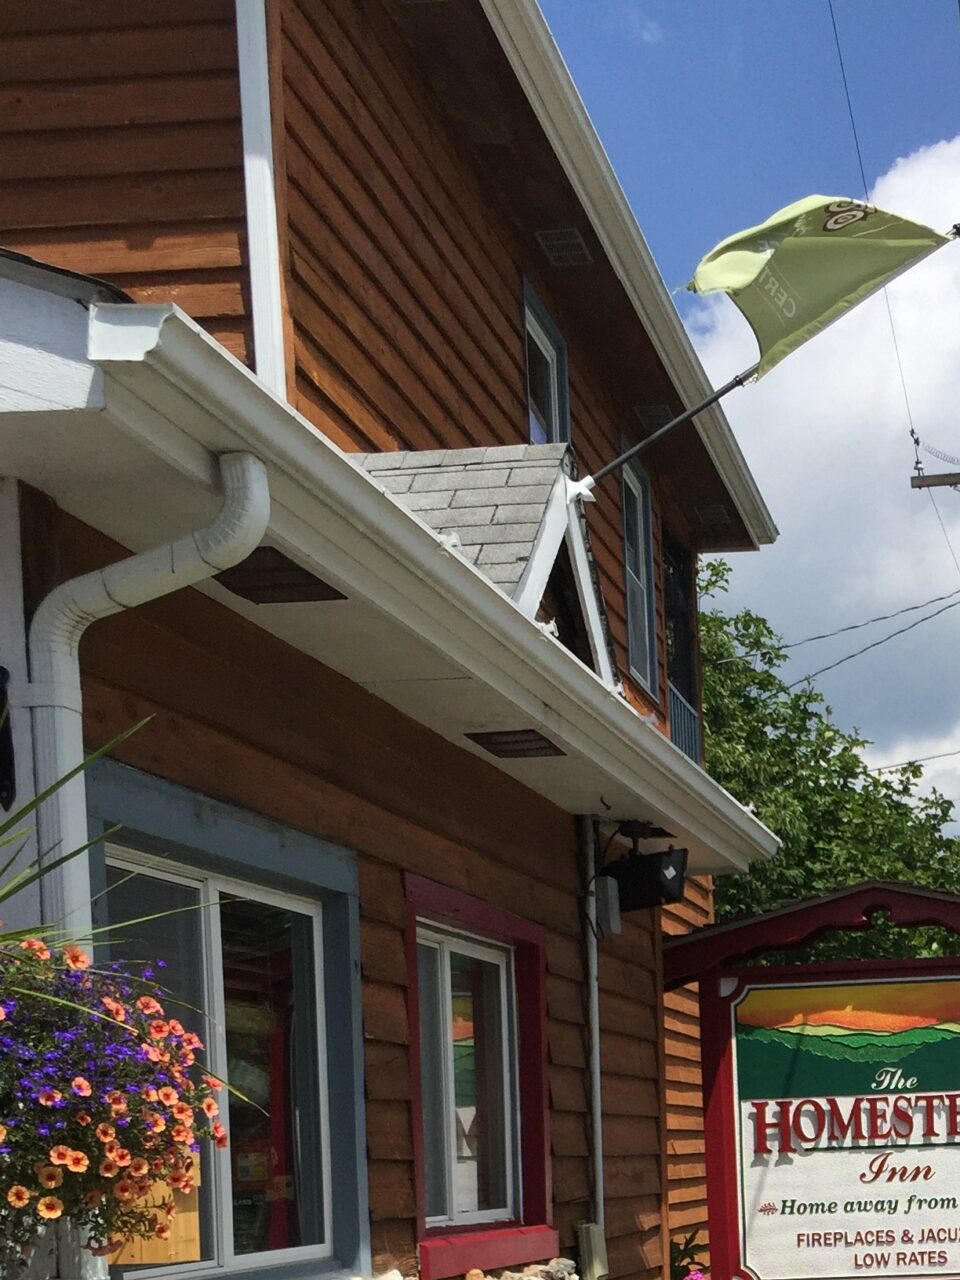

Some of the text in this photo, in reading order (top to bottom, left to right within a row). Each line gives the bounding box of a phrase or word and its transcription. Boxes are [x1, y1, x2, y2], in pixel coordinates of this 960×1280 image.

[871, 1067, 919, 1090] The
[859, 1151, 936, 1184] Inn
[780, 1199, 838, 1216] Home
[843, 1199, 899, 1215] away
[903, 1194, 959, 1214] from
[796, 1229, 896, 1248] FIREPLACES
[900, 1228, 914, 1244] &
[854, 1250, 949, 1270] LOW RATES
